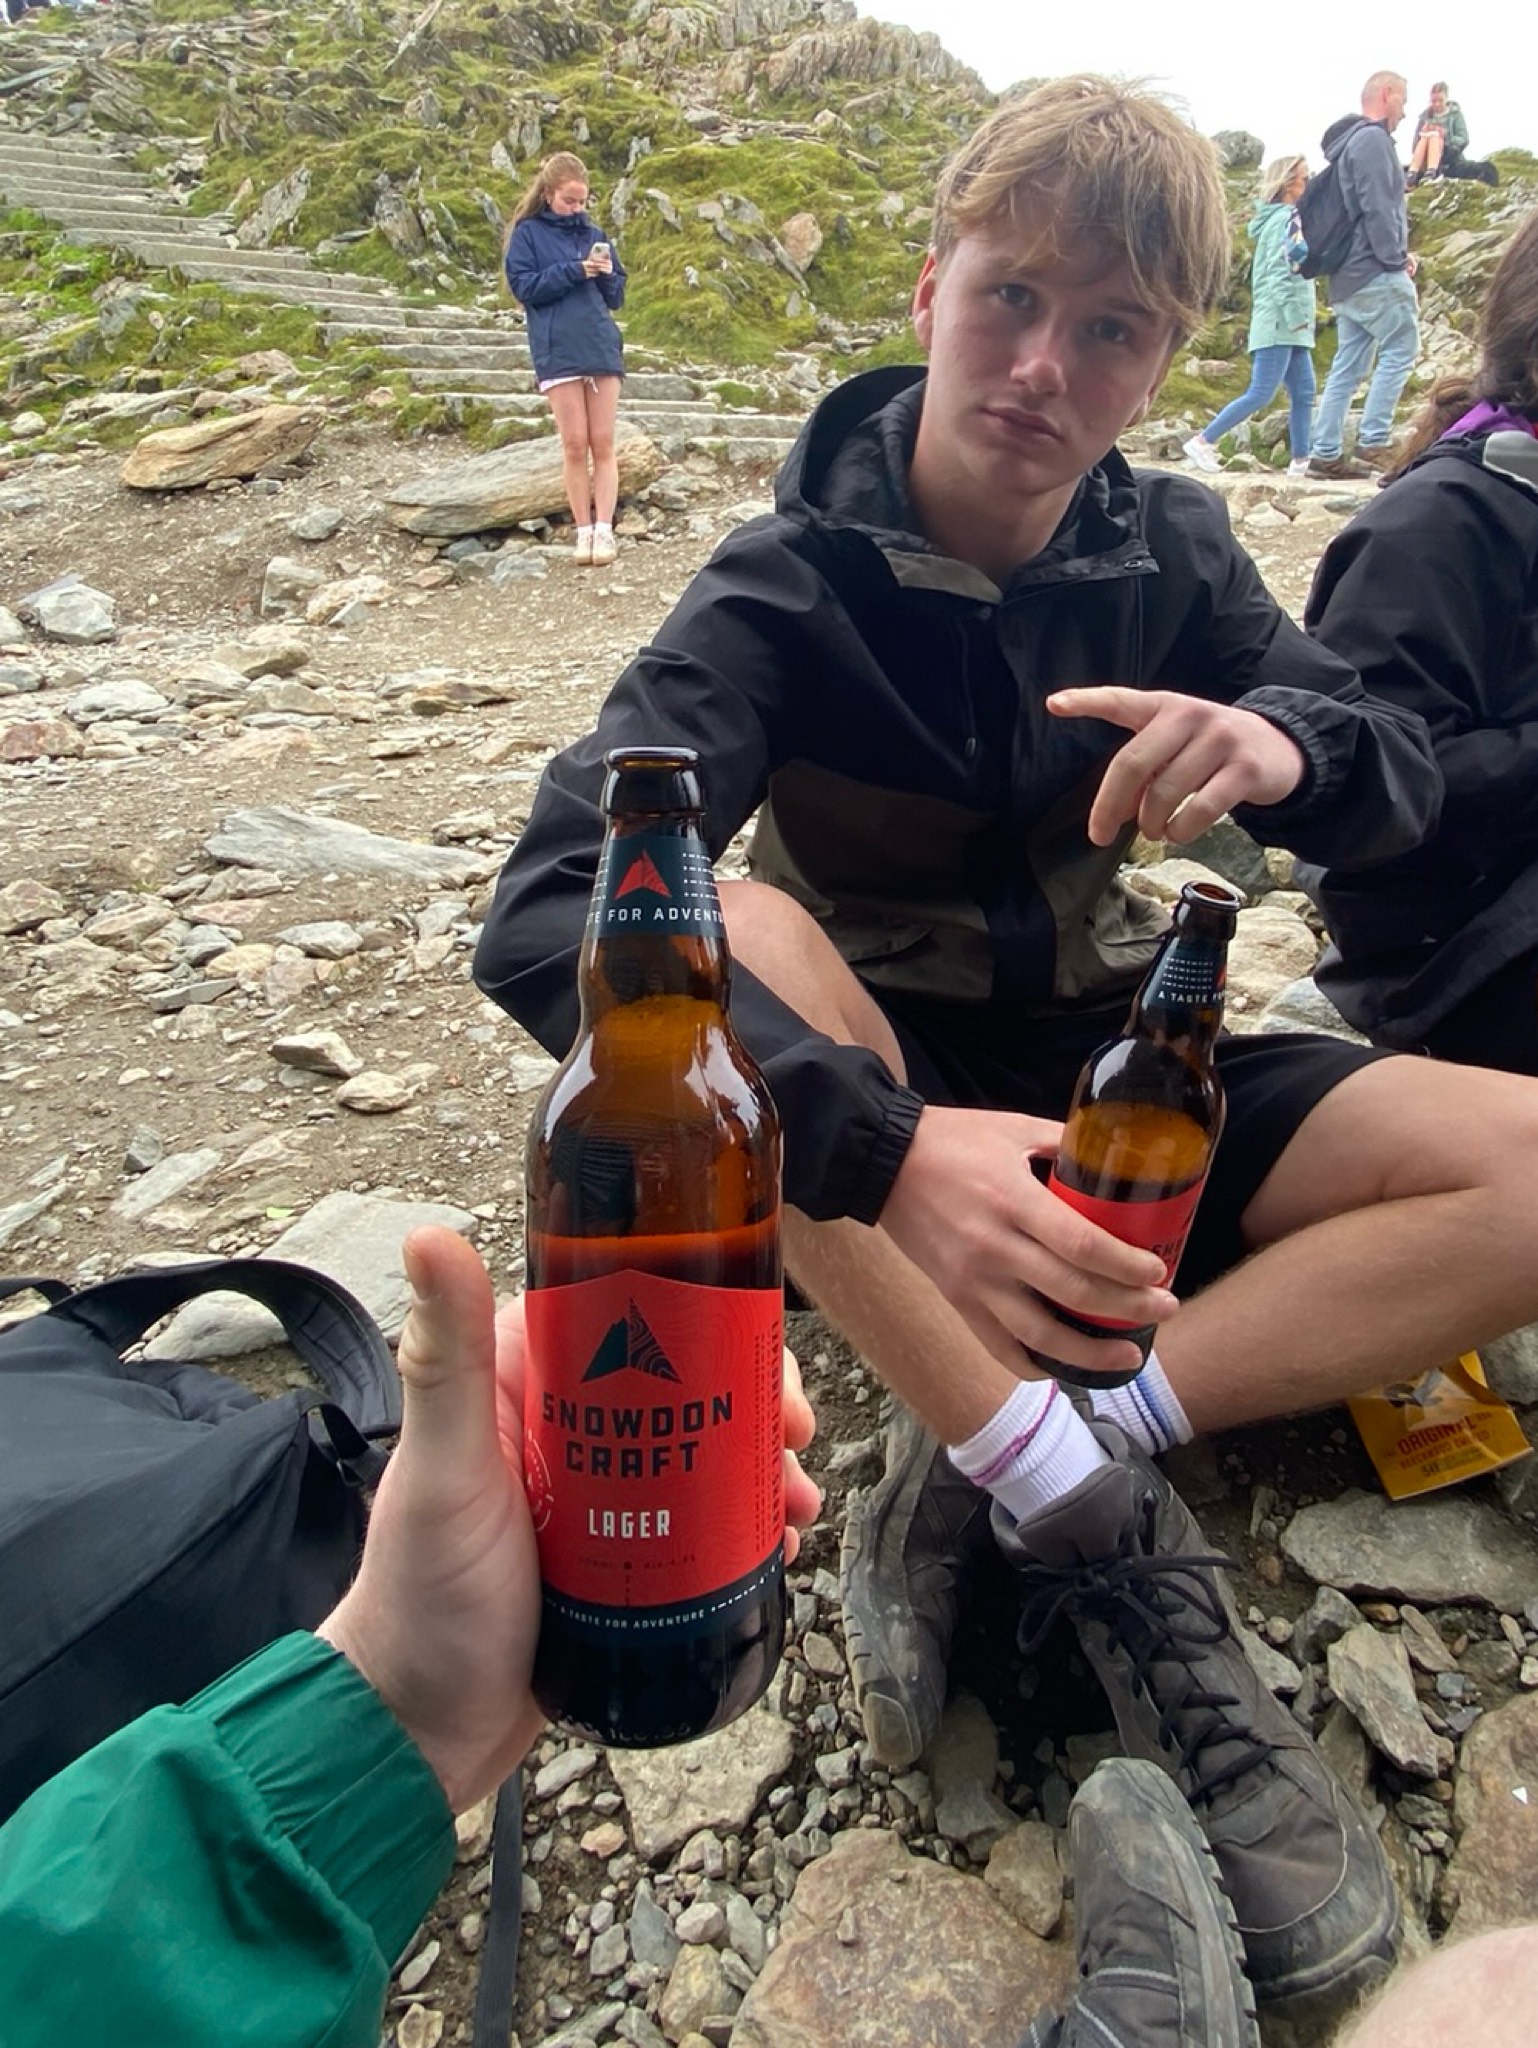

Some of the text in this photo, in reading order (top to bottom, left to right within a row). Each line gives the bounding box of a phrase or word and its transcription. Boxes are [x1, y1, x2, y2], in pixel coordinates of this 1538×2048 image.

[608, 908, 642, 922] FOR
[1158, 990, 1166, 1000] A
[1170, 992, 1208, 1003] TASTE
[542, 1391, 733, 1439] SNOWDON
[566, 1440, 699, 1479] CRAFT
[588, 1508, 671, 1539] LAGER
[569, 1609, 600, 1625] TASTE
[605, 1618, 628, 1628] FOR
[633, 1608, 705, 1628] ADVENTURE
